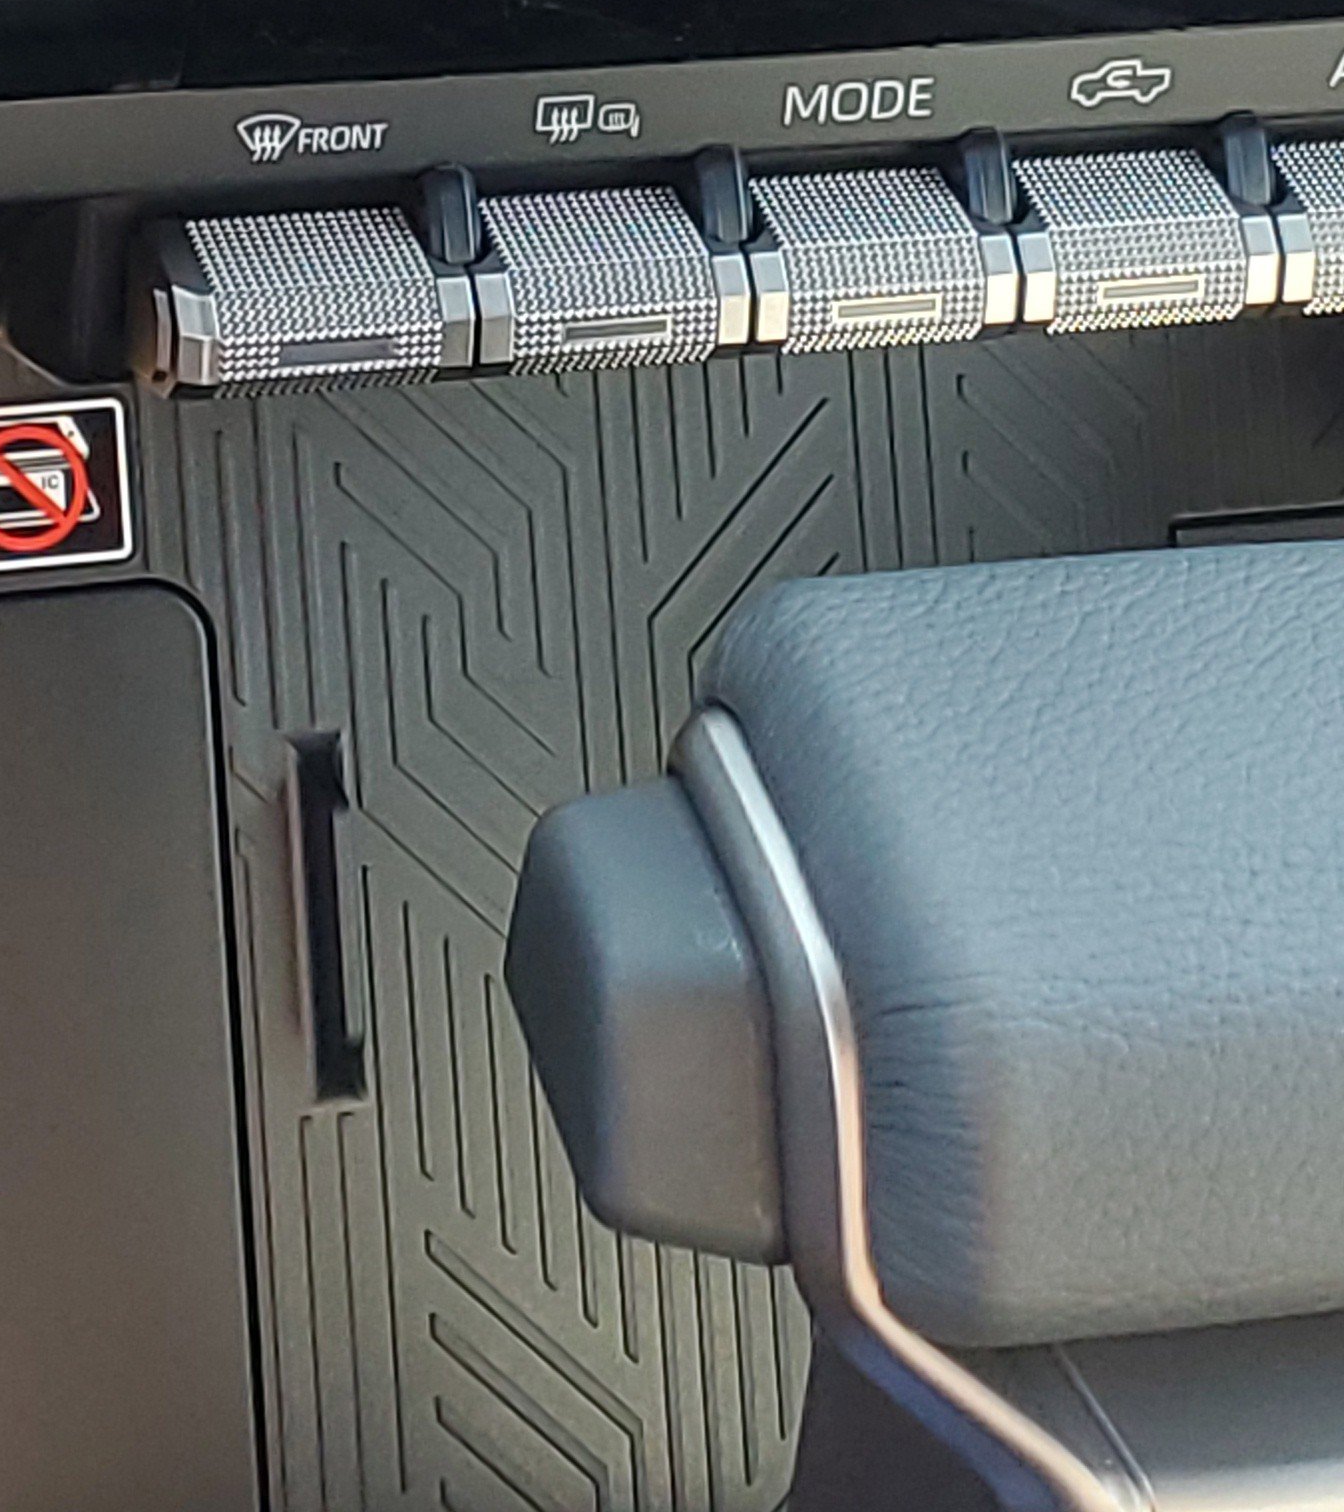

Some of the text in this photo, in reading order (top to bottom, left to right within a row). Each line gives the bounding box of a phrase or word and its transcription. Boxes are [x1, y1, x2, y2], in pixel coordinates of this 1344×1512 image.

[783, 76, 936, 125] MODE
[297, 122, 388, 153] FRONT
[41, 474, 60, 490] IC
